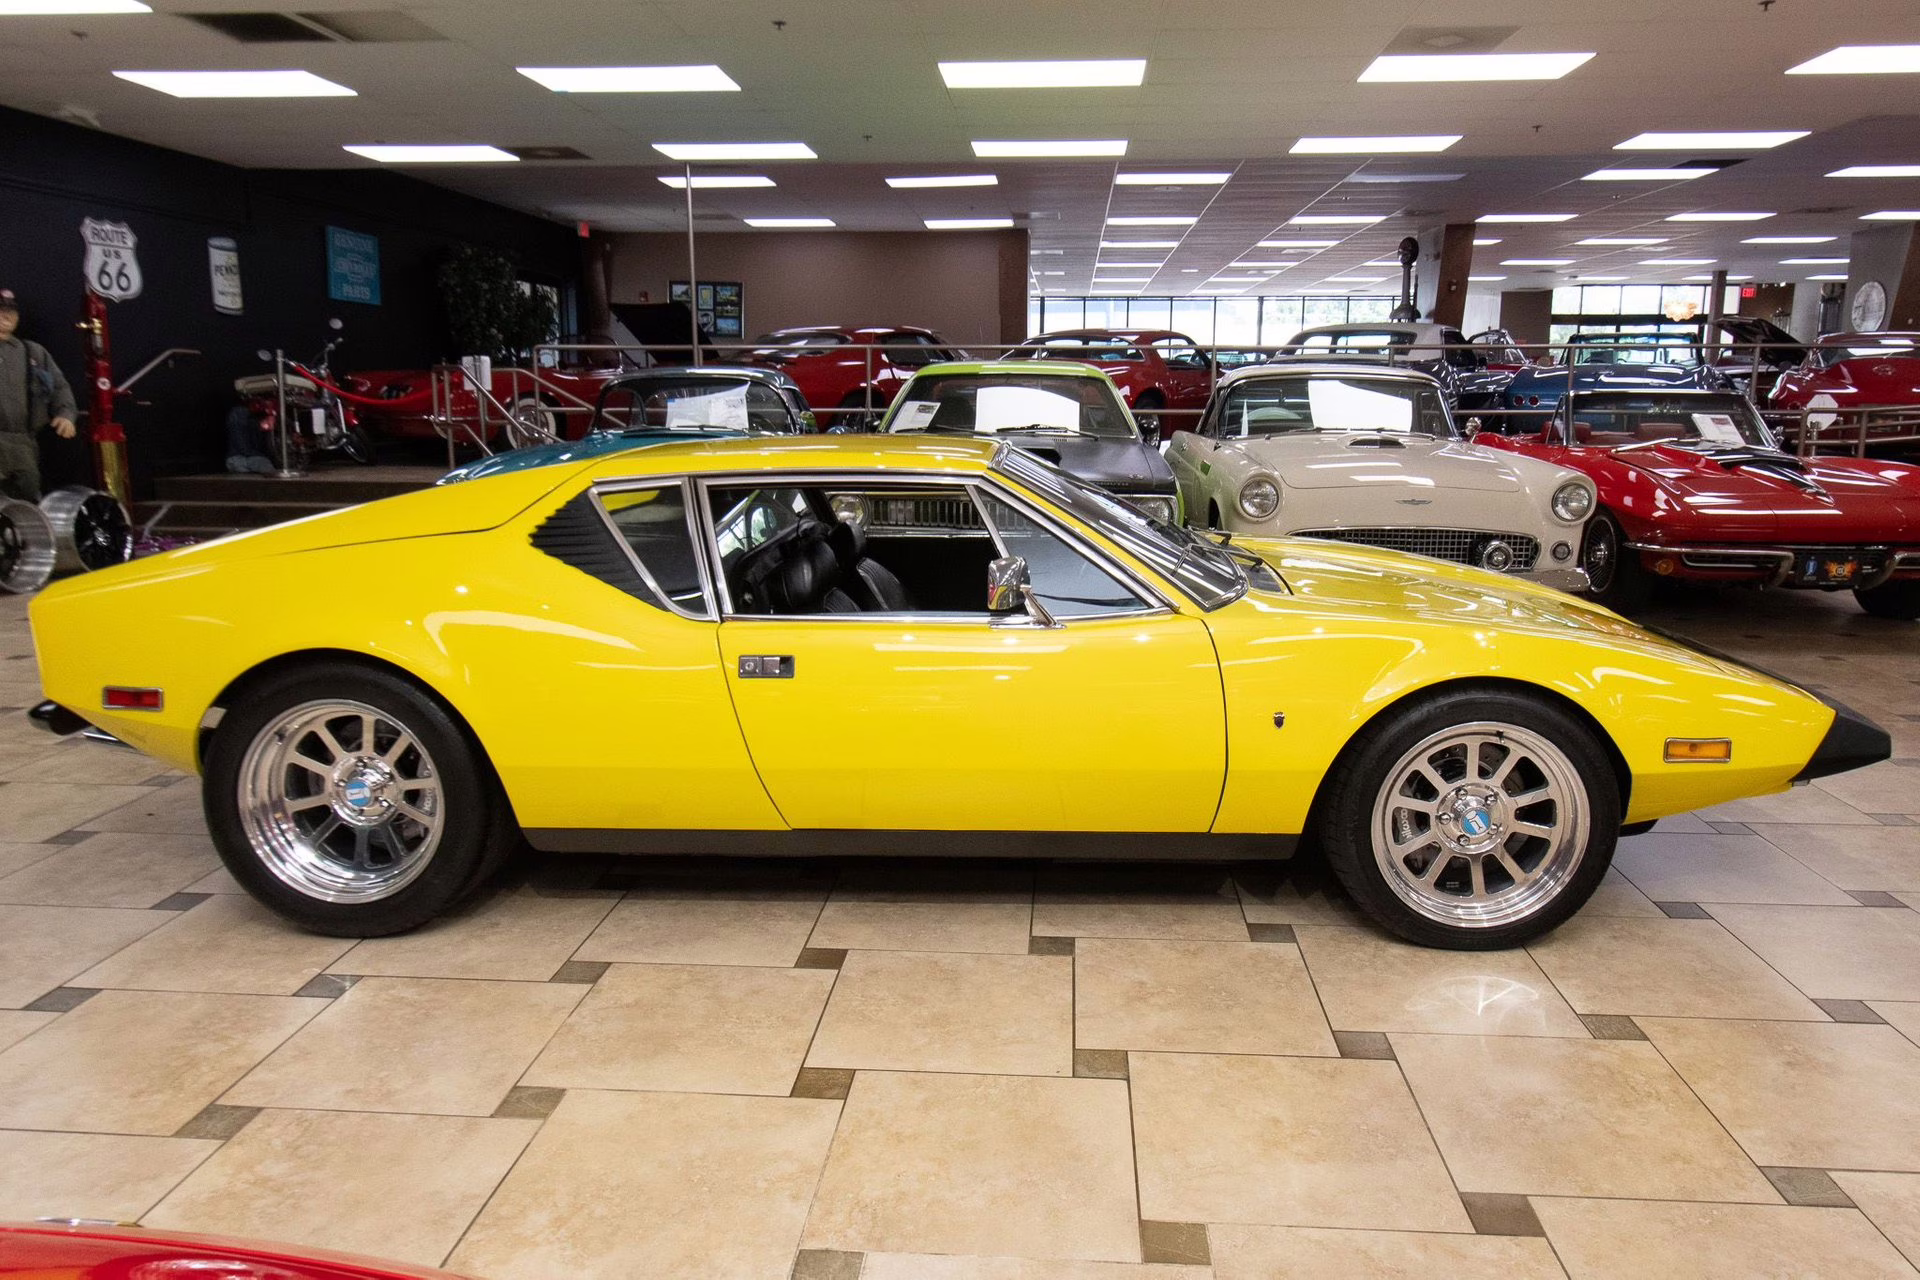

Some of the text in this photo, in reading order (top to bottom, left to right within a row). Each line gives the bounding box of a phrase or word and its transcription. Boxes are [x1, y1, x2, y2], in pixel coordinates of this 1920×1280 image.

[90, 226, 128, 245] ROUTE
[102, 248, 122, 260] US
[98, 260, 132, 292] 66
